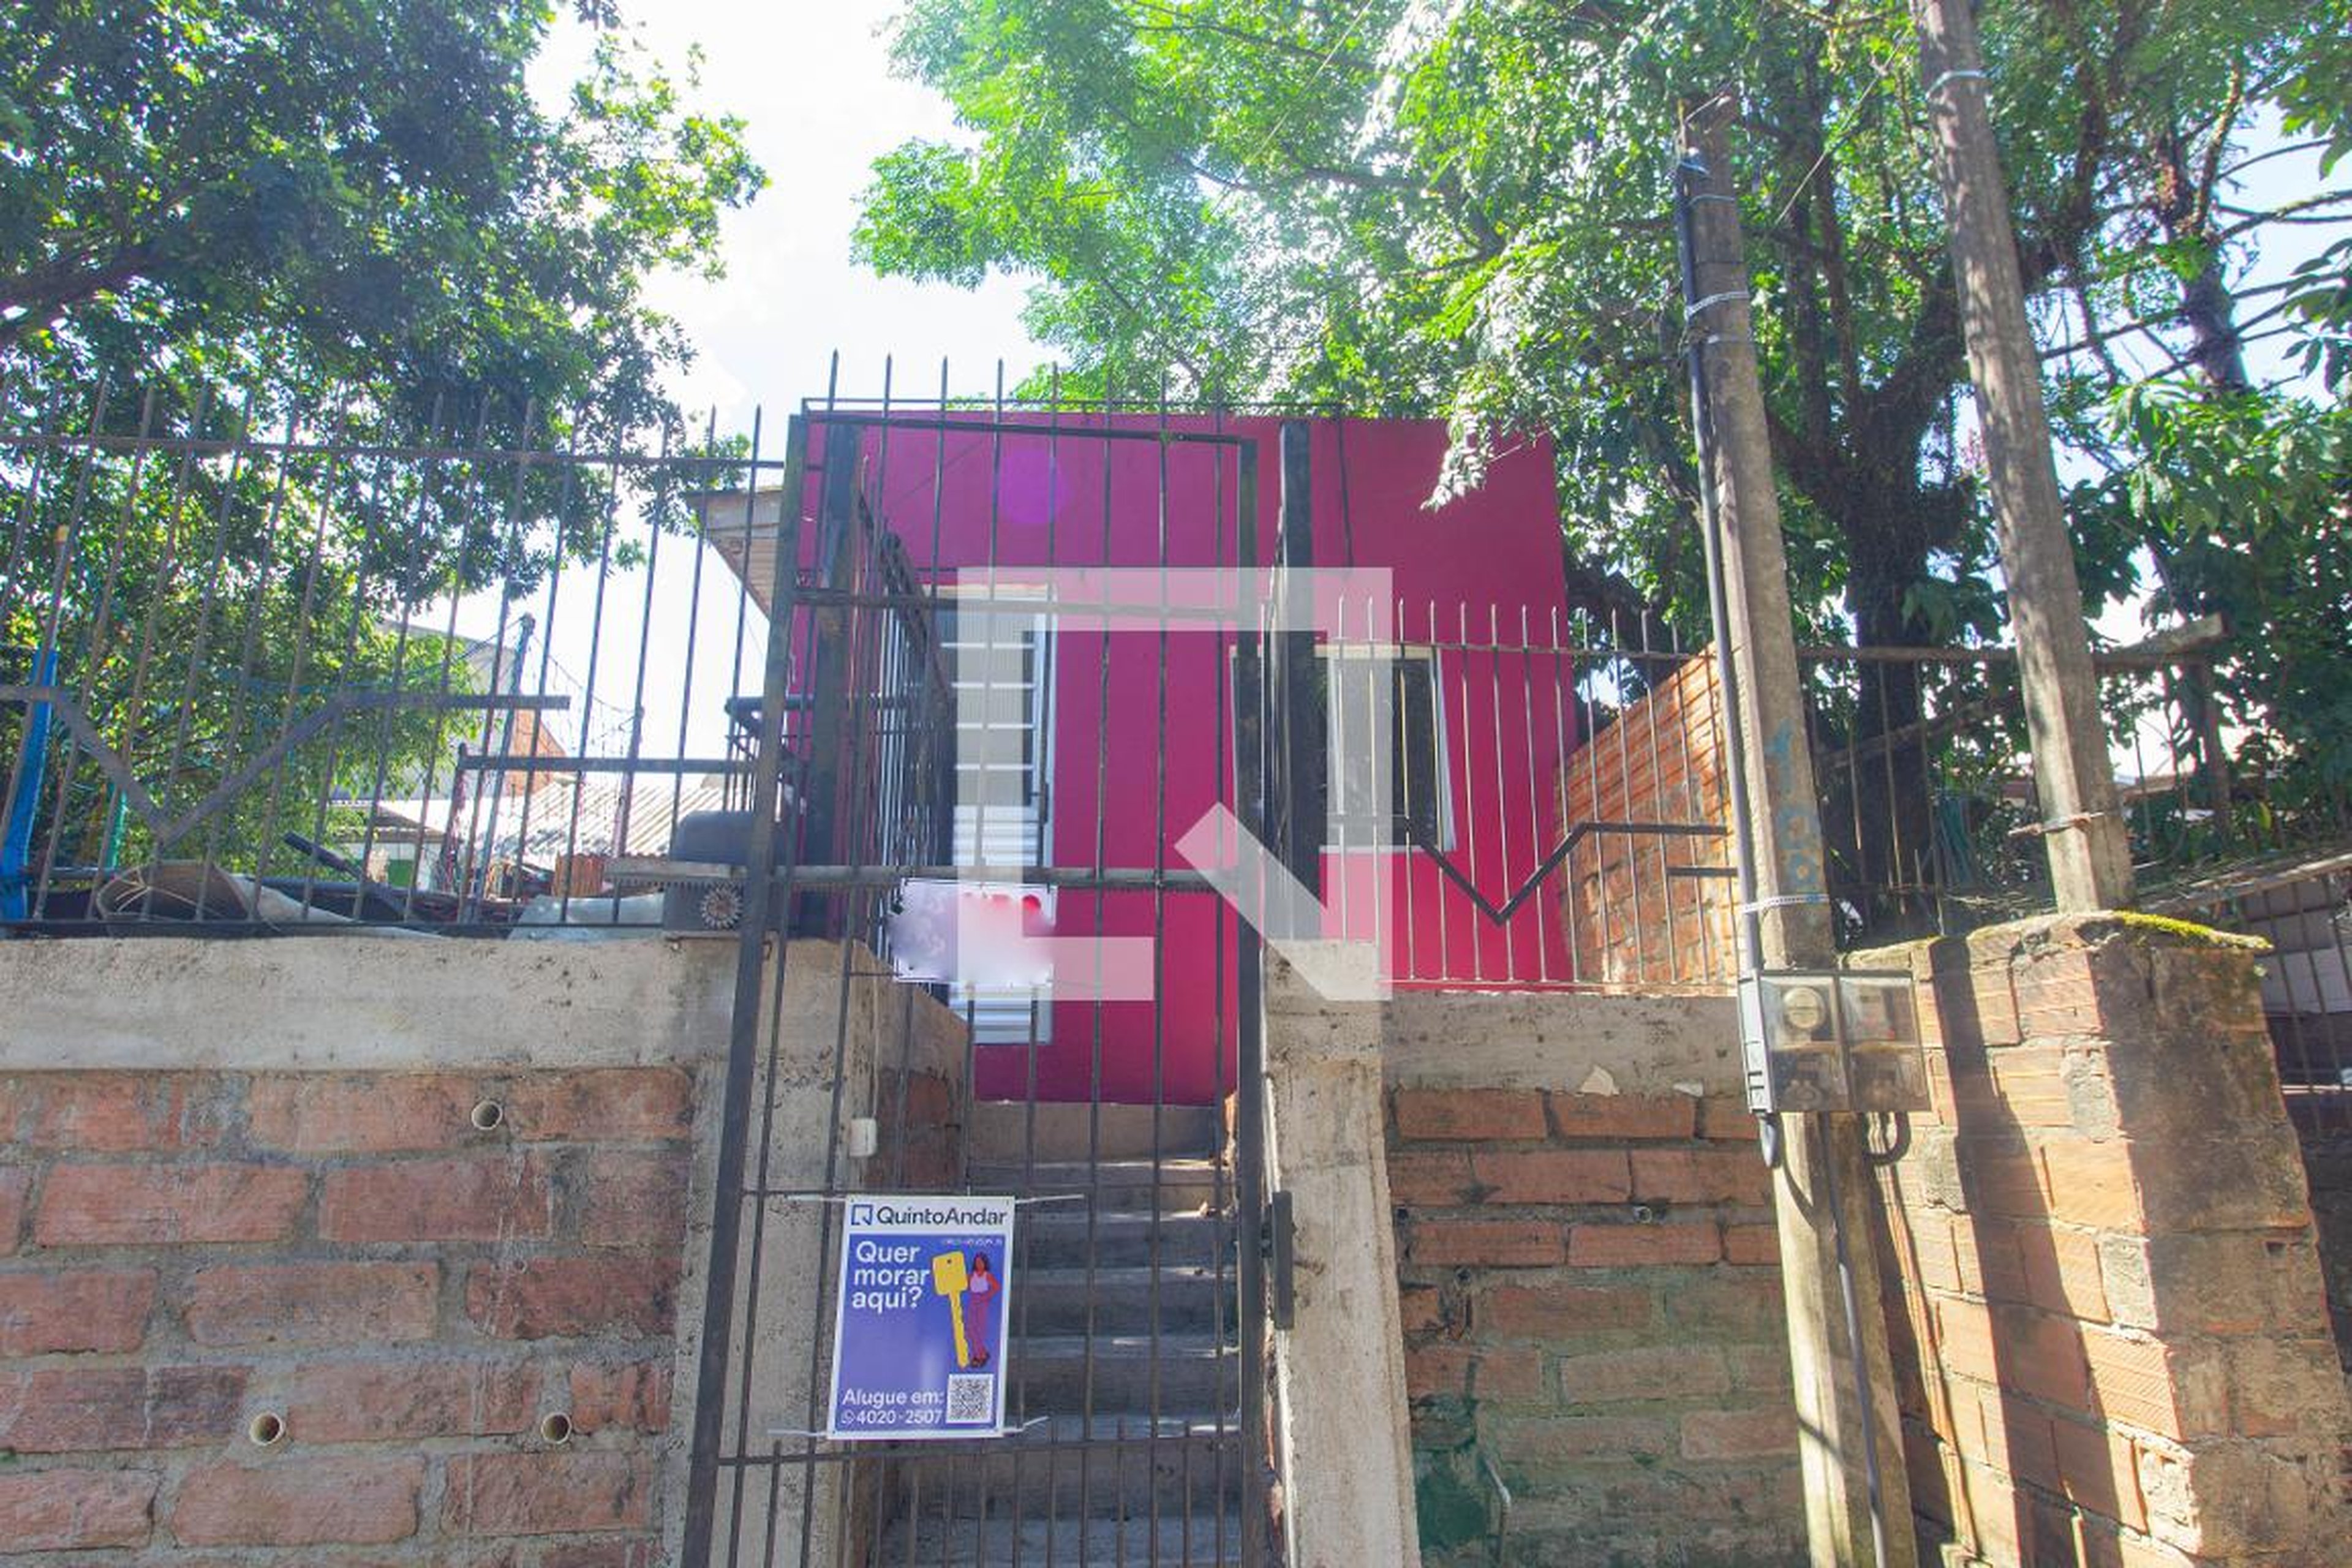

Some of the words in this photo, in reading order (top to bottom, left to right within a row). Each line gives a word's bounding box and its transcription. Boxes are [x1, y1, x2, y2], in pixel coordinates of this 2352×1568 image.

[876, 1205, 1008, 1225] QuintoAndar
[856, 1240, 921, 1263] Quer
[854, 1268, 930, 1286] morar
[852, 1286, 922, 1314] aqui?
[842, 1388, 908, 1409] Alugue
[911, 1391, 945, 1405] em:
